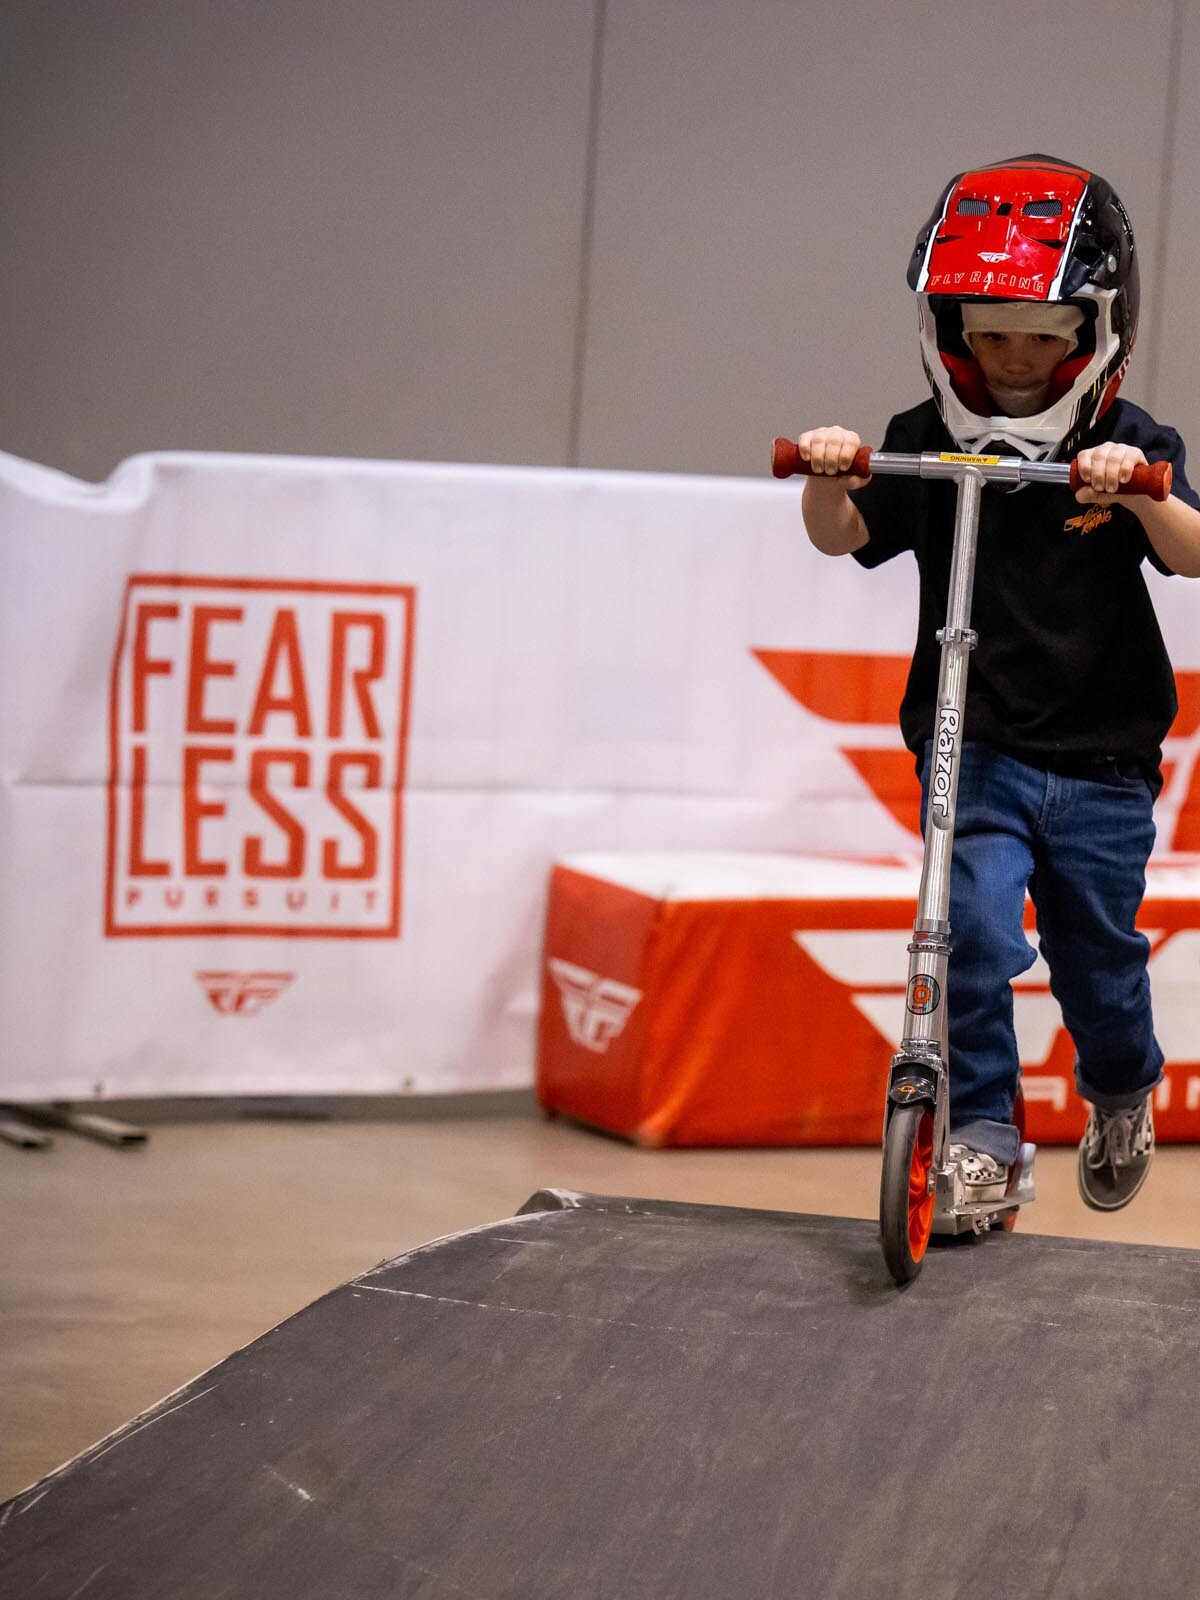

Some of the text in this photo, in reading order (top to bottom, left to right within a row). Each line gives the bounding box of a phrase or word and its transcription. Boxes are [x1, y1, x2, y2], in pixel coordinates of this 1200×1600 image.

[930, 271, 1044, 293] FLY RACING
[130, 603, 387, 740] FEAR
[128, 744, 383, 880] LESS
[932, 708, 960, 818] Razor
[125, 887, 378, 910] PURSUIT
